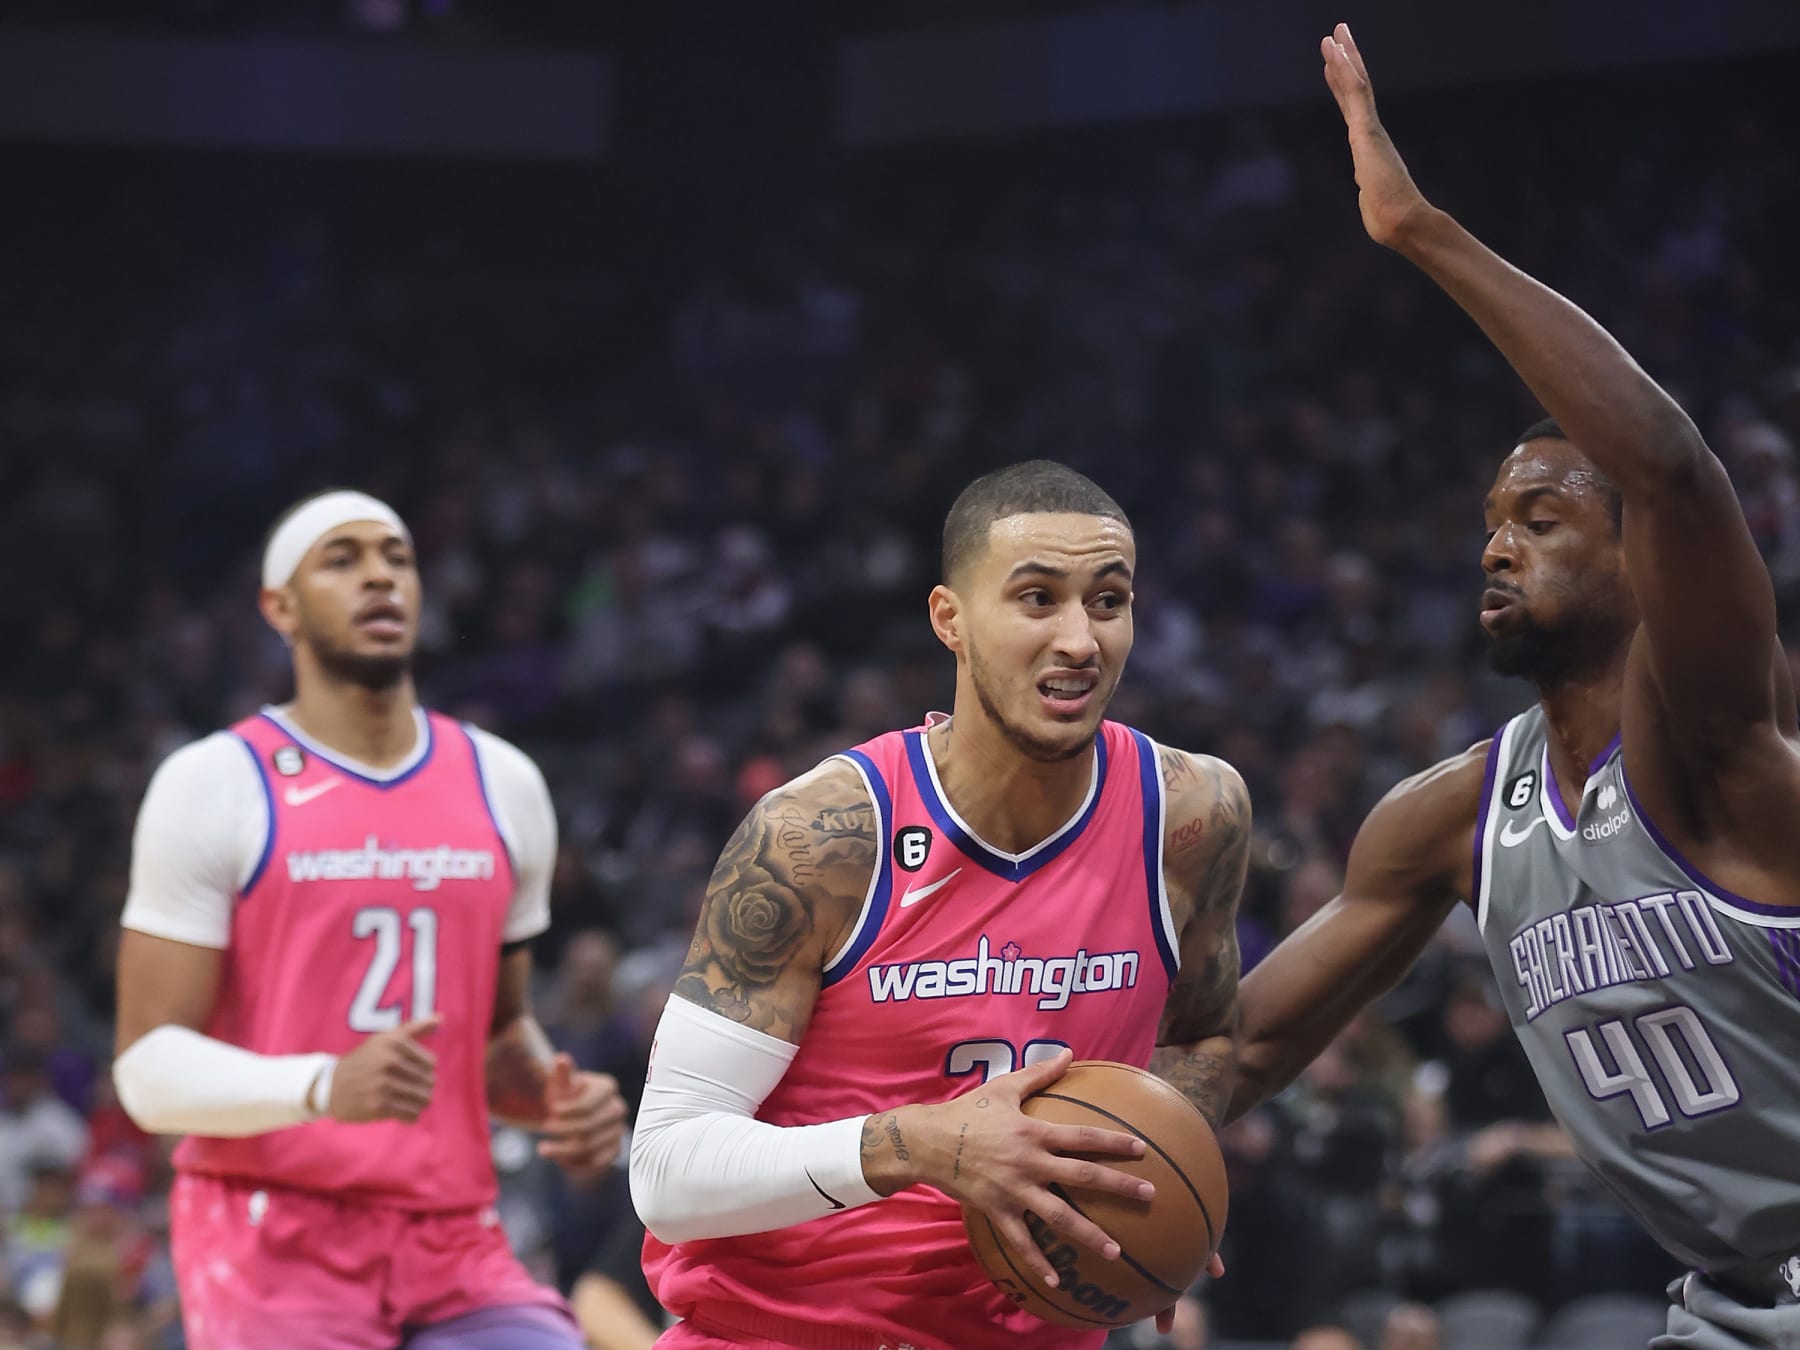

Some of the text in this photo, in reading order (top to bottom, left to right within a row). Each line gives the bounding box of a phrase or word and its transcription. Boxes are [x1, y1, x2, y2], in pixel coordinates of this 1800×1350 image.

[1509, 774, 1534, 807] 6
[287, 836, 492, 891] washington
[902, 831, 927, 868] 6
[347, 906, 439, 1033] 21
[867, 935, 1139, 1011] washington
[1562, 1003, 1742, 1132] 40
